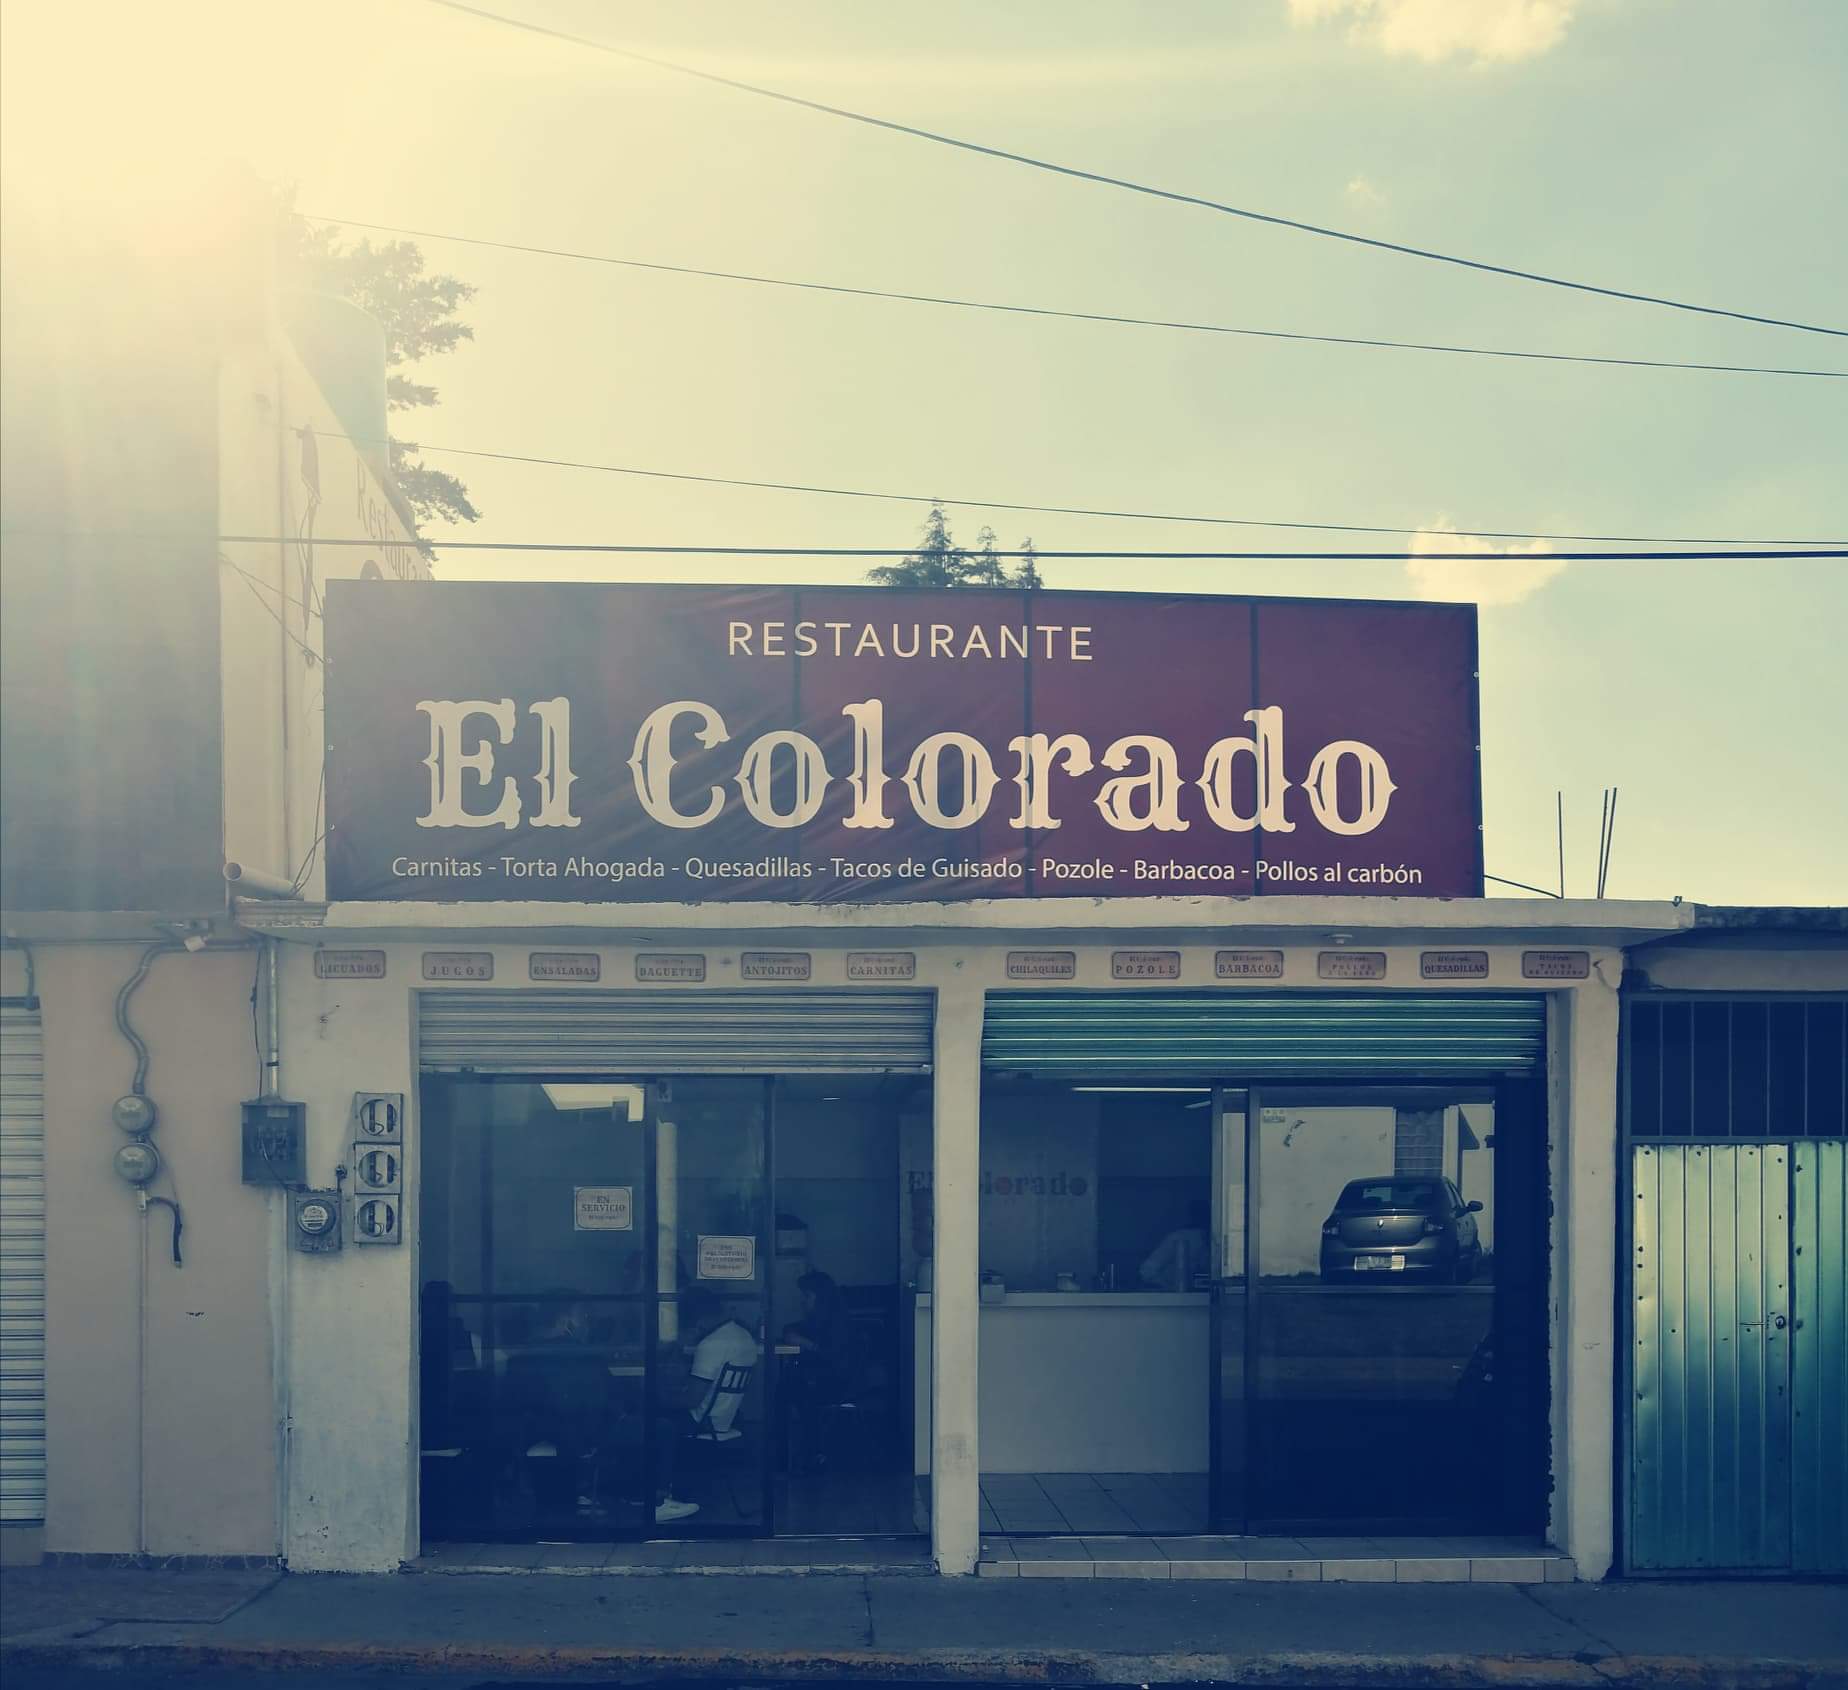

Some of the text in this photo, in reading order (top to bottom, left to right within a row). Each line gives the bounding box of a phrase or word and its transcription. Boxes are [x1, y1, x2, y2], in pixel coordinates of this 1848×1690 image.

[728, 621, 1093, 661] RESTAURANTE
[415, 696, 1399, 836] El Colorado
[392, 856, 483, 877] Carnitas
[501, 857, 558, 877] Torta
[564, 857, 665, 883] Ahogada
[685, 857, 813, 880] Quesadillas
[830, 858, 892, 878] Tacos
[898, 857, 927, 878] de
[931, 857, 1023, 878] Guisado
[1042, 858, 1115, 880] Pozole
[1134, 858, 1235, 881] Barbacoa
[1255, 859, 1319, 882] Pollos
[1323, 862, 1342, 882] al
[1347, 862, 1423, 884] carbón
[743, 965, 808, 976] ANTOJITOS
[850, 965, 913, 977] CARNITAS
[1010, 964, 1073, 975] CHILAQUILES
[1115, 964, 1177, 975] POZOLE
[1218, 963, 1281, 975] BARBACOA
[1424, 963, 1487, 975] QUESADILLAS
[980, 1169, 1089, 1197] lorado
[581, 1203, 626, 1212] SERVICIO
